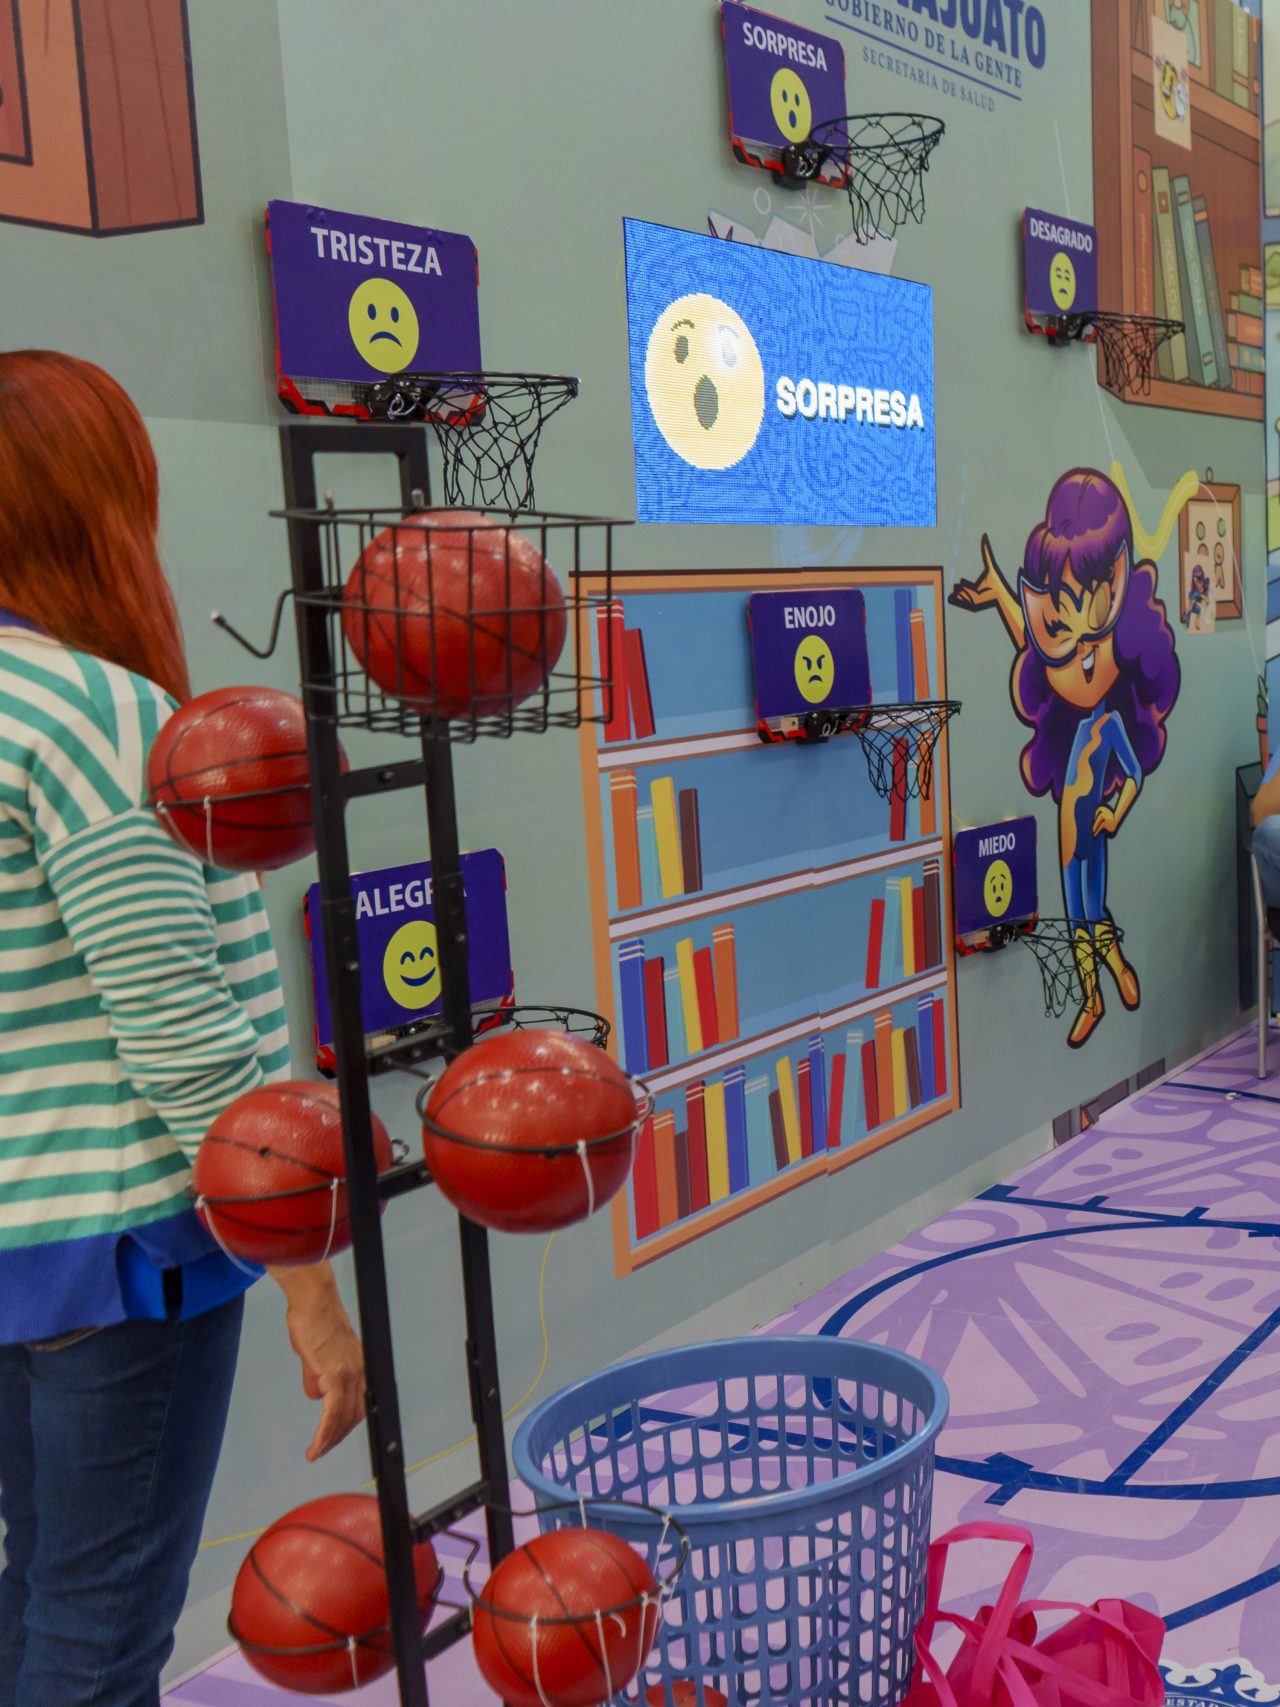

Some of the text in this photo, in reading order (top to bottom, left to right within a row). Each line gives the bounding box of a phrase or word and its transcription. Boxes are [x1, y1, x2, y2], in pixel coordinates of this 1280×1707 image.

[742, 21, 828, 72] SORPRESA
[825, 0, 1022, 88] OBIERNO DE LA GENTE
[942, 78, 957, 97] DE
[960, 85, 995, 112] SALUD
[310, 226, 443, 277] TRISTEZA
[1029, 217, 1093, 254] DESAGRADO
[776, 375, 925, 430] SORPRESA
[784, 605, 836, 629] ENOJO
[978, 832, 1016, 858] MIEDO
